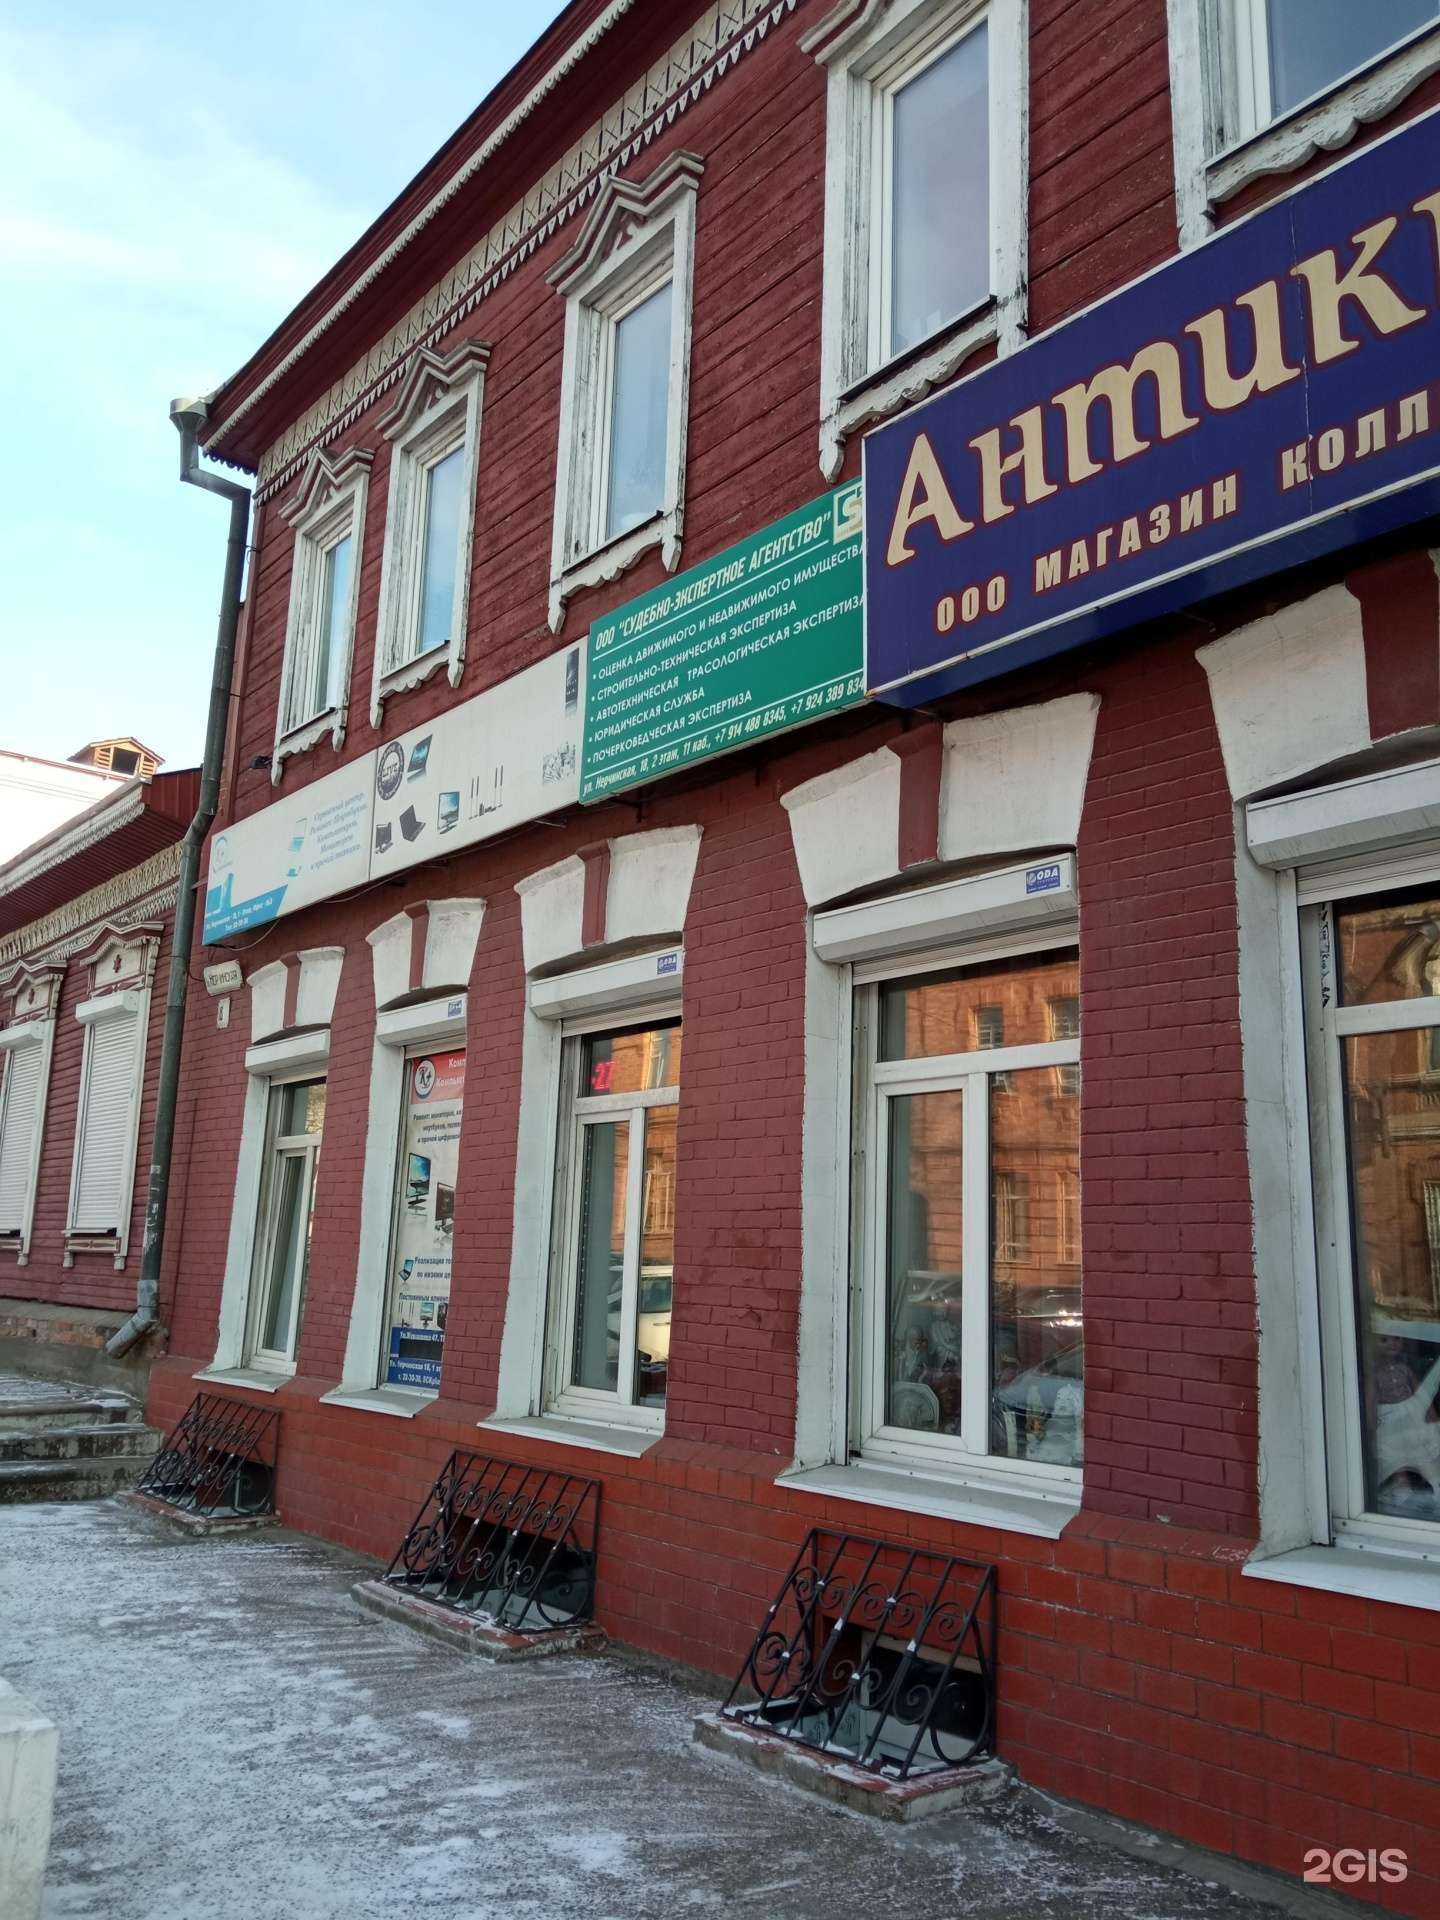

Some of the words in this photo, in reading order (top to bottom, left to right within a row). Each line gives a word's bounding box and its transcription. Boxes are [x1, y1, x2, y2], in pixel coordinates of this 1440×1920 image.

[886, 191, 1440, 567] Антик
[595, 626, 616, 651] ООО
[619, 556, 747, 637] "СУДЕБНО-ЭКСПЕРТНОЕ
[748, 511, 832, 573] АГЕНТСТВО"
[935, 575, 1007, 632] ООО
[1035, 474, 1238, 593] МАГАЗИН
[595, 676, 679, 722] АВТОТЕХНИЧЕСКАЯ
[687, 626, 790, 681] ТРАСОЛОГИЧЕСКАЯ
[597, 632, 727, 701] СТРОИТЕЛЬНО-ТЕХНИЧЕСКАЯ
[729, 600, 797, 640] ЭКСПЕРТИЗА
[598, 655, 633, 680] ОЦЕНКА
[634, 624, 697, 664] ДВИЖИМОГО
[699, 618, 706, 631] И
[708, 578, 791, 627] НЕДВИЖИМОГО
[592, 717, 685, 764] ПОЧЕРКОВЕДЧЕСКАЯ
[688, 690, 752, 725] ЭКСПЕРТИЗА
[594, 705, 661, 742] ЮРИДИЧЕСКАЯ
[663, 687, 705, 713] СЛУЖБА
[651, 754, 658, 769] 2
[727, 722, 743, 740] 914
[805, 691, 824, 711] 924
